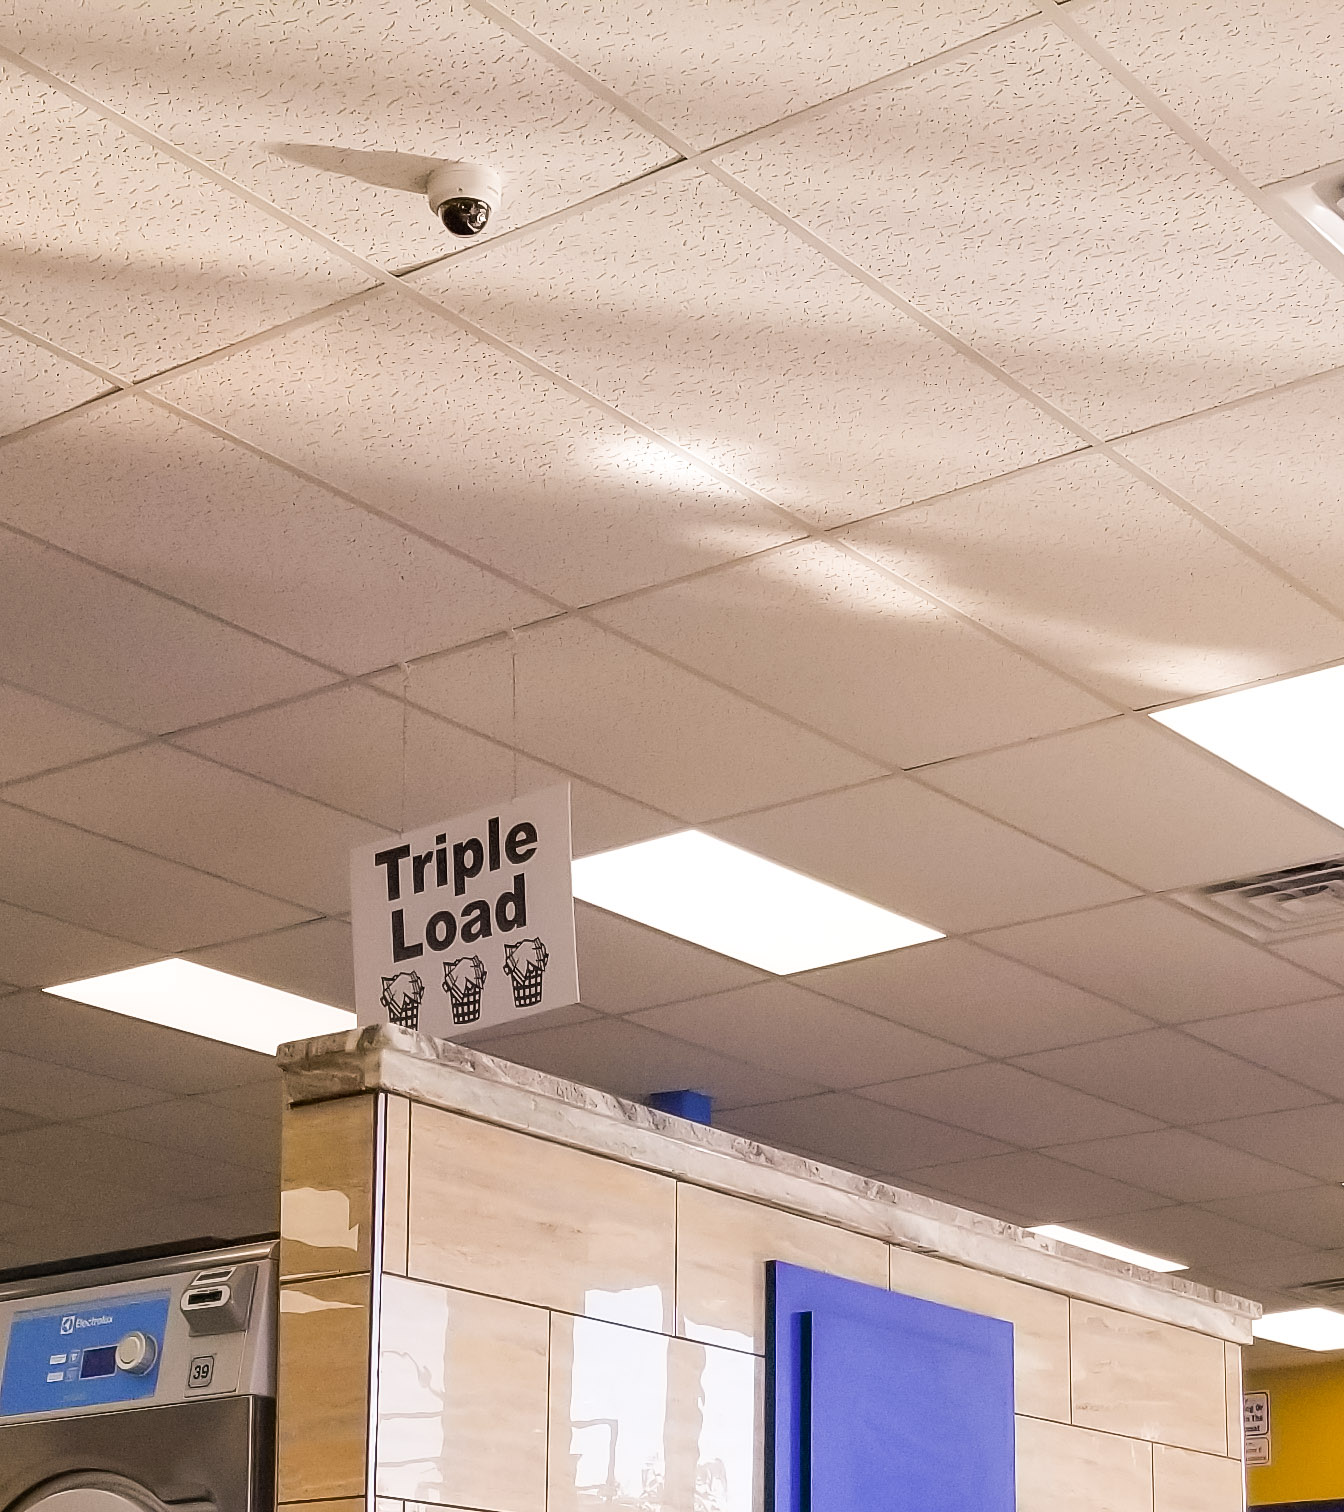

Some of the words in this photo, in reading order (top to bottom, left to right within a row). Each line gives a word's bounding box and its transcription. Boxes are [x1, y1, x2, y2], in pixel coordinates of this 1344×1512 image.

[374, 816, 538, 901] Triple
[391, 872, 527, 963] Load
[75, 1315, 113, 1329] Electrolux
[193, 1364, 210, 1379] 39
